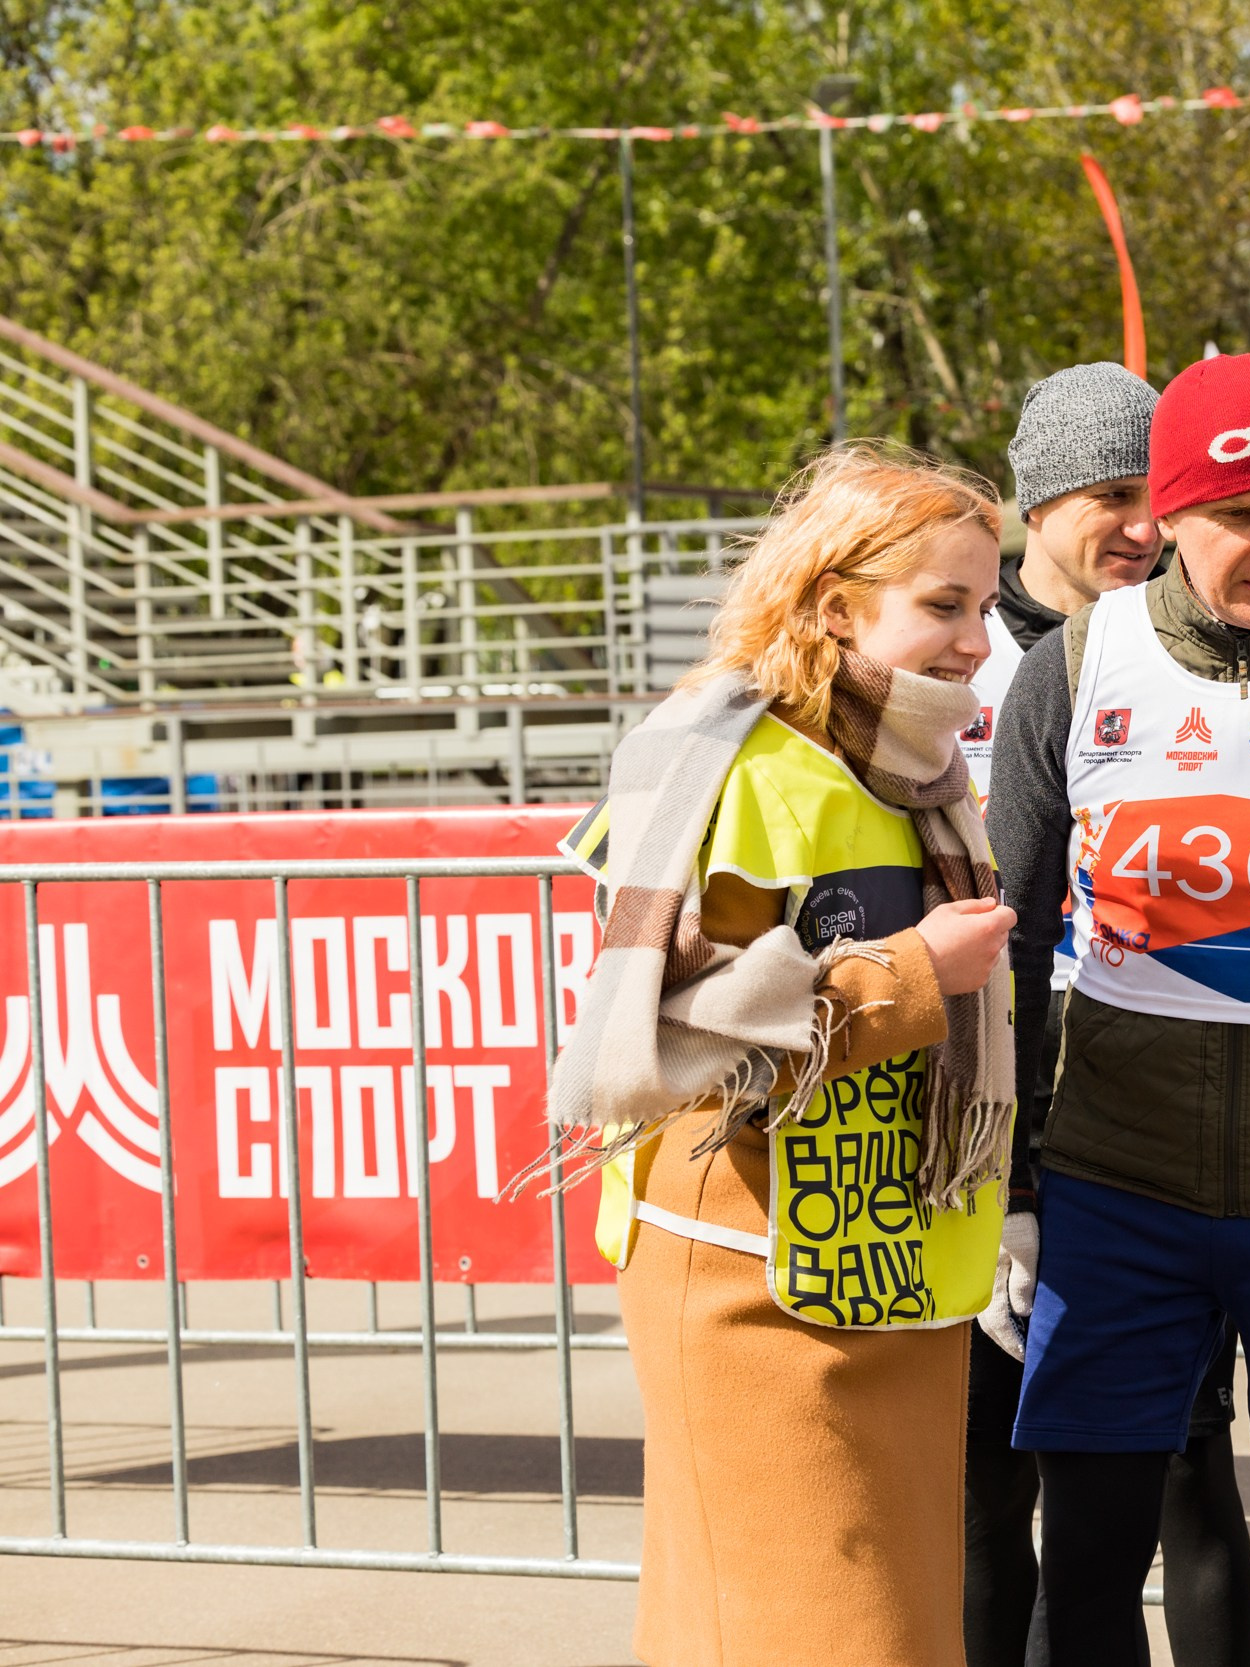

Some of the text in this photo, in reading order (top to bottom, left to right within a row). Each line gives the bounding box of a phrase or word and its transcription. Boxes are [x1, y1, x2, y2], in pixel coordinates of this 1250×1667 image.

[1106, 756, 1133, 764] Москвы
[1119, 749, 1142, 757] спорта
[1166, 750, 1218, 761] МОСКОВСКИЙ
[1177, 762, 1204, 772] СПОРТ
[820, 922, 855, 939] BAND
[1090, 937, 1125, 968] ГТО
[215, 1065, 511, 1199] СПОРТ
[785, 1129, 921, 1189] BAND
[788, 1240, 926, 1301] BAND
